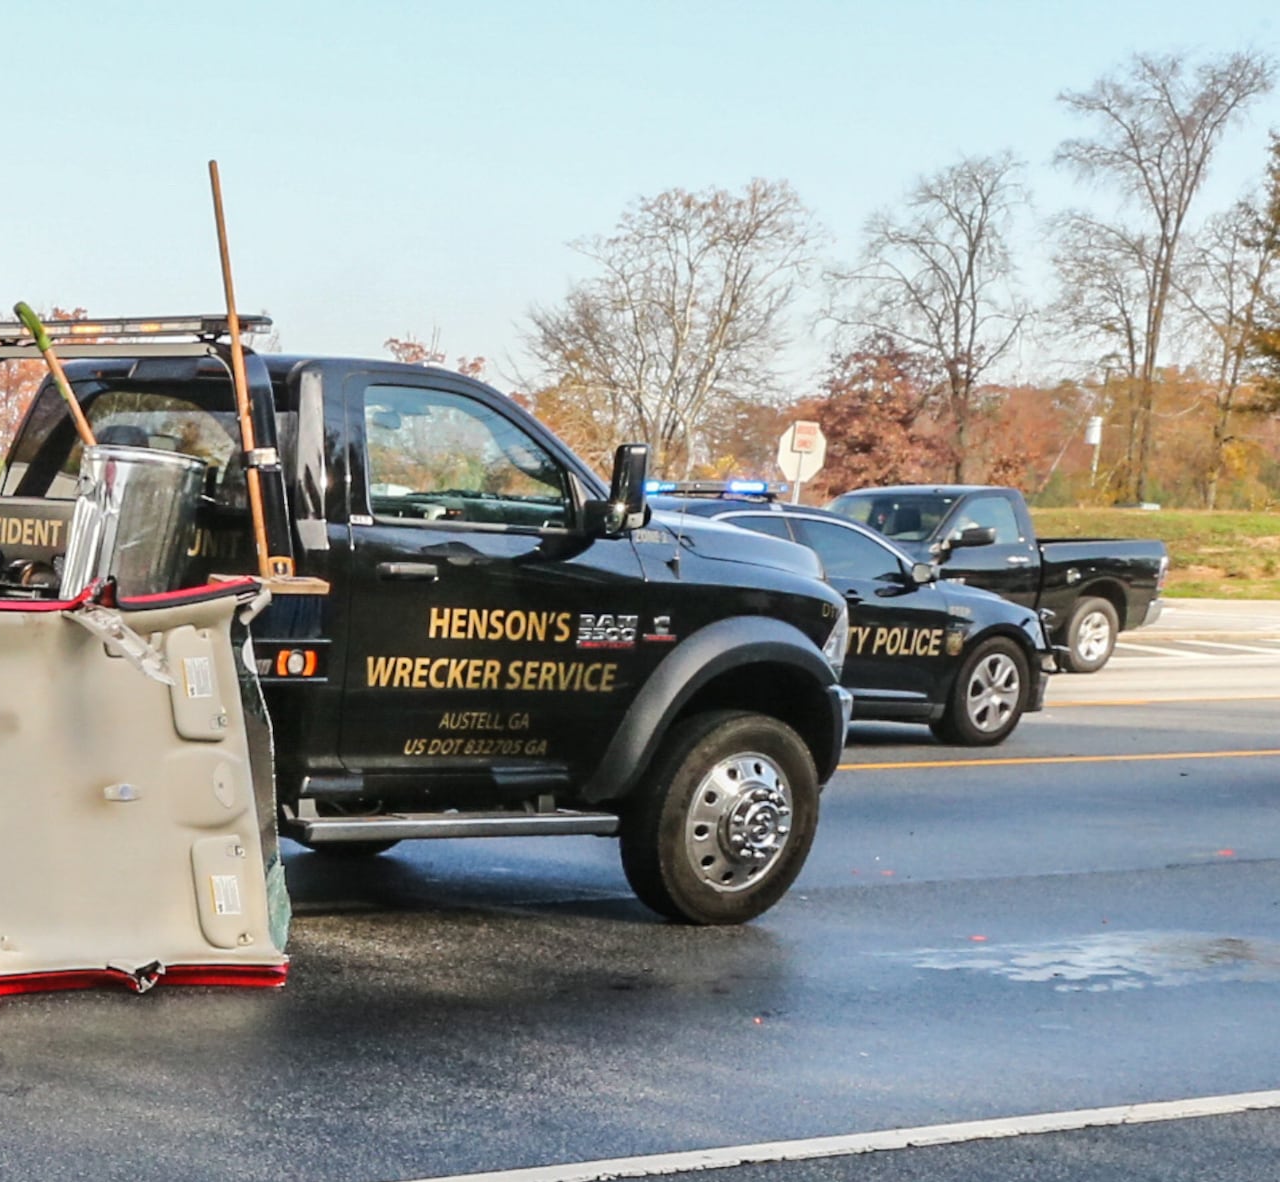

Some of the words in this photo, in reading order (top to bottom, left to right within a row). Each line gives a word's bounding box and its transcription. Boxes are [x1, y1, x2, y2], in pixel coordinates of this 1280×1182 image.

[428, 607, 571, 642] HENSON'S
[872, 627, 944, 656] POLICE
[366, 656, 501, 690] WRECKER
[505, 660, 617, 691] SERVICE
[508, 713, 530, 731] GA
[403, 739, 426, 755] US
[427, 739, 463, 755] DOT
[524, 740, 548, 755] GA
